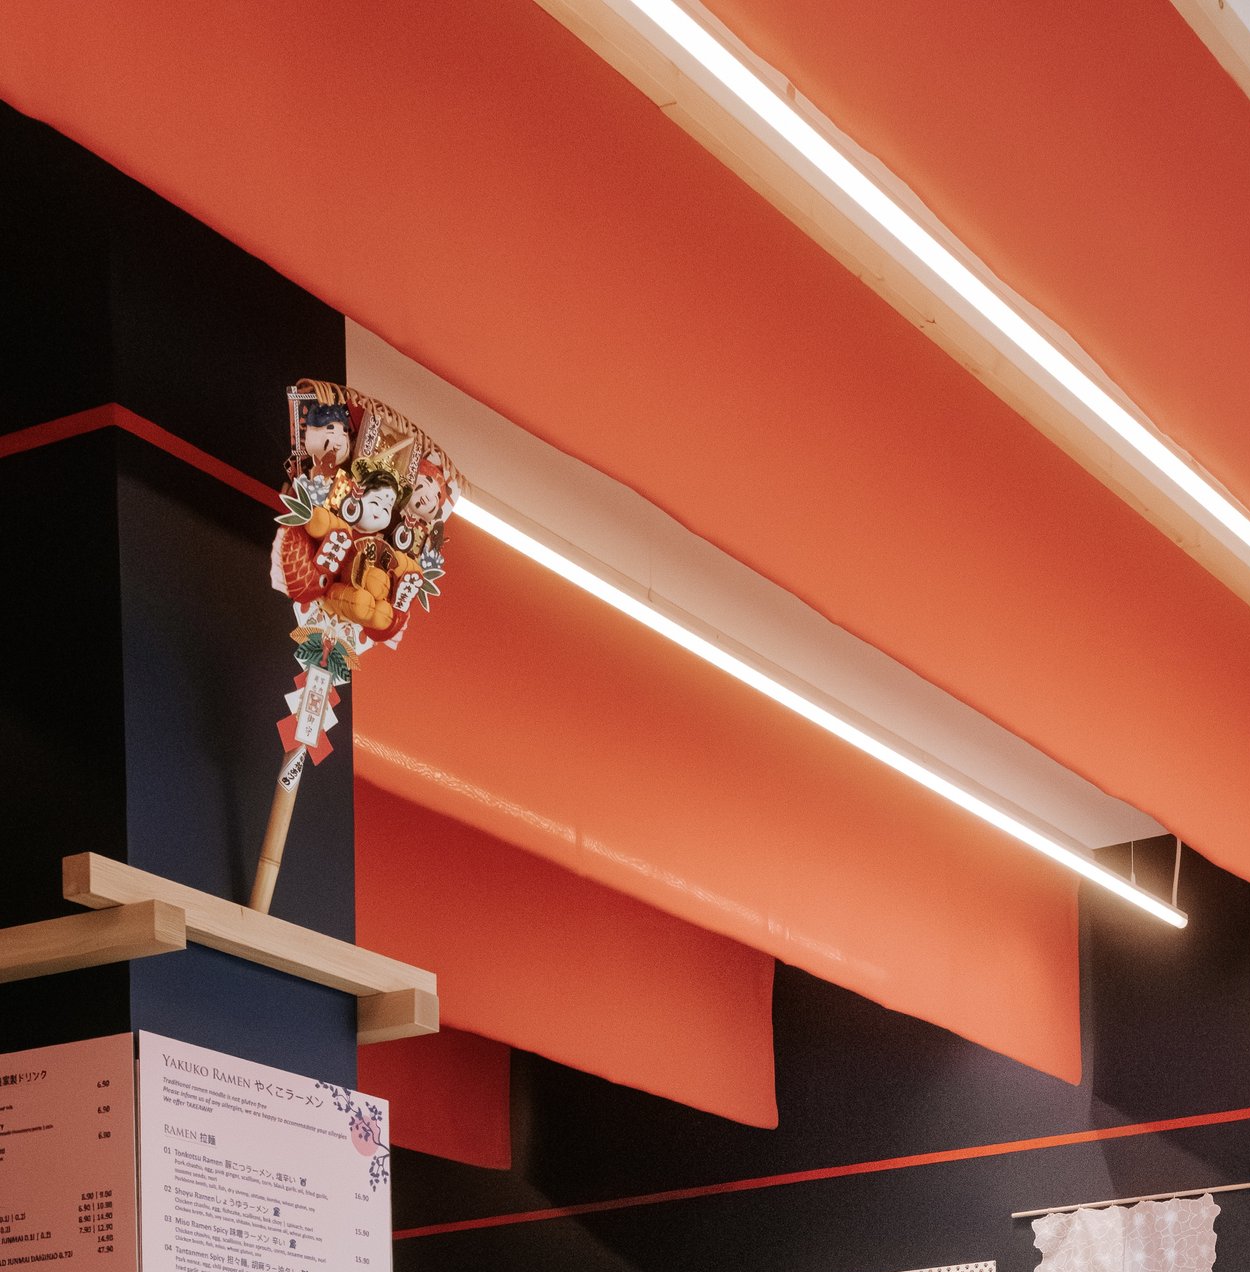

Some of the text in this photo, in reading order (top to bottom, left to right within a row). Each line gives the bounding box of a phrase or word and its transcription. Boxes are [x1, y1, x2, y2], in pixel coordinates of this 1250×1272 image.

[162, 1055, 323, 1109] YAKUKO RAMEN やくこラーメン
[164, 1123, 196, 1140] RAMEN
[163, 1145, 170, 1154] 01
[202, 1156, 223, 1166] Ramen
[163, 1184, 171, 1192] 02
[174, 1186, 193, 1197] Shoyu
[194, 1191, 215, 1202] Ramen
[164, 1214, 171, 1222] 03
[175, 1216, 190, 1226] Miso
[191, 1220, 211, 1230] Ramen
[213, 1225, 228, 1235] Spicy
[164, 1243, 172, 1251] 04
[175, 1246, 208, 1258] Tantanmen
[209, 1253, 224, 1263] Spicy
